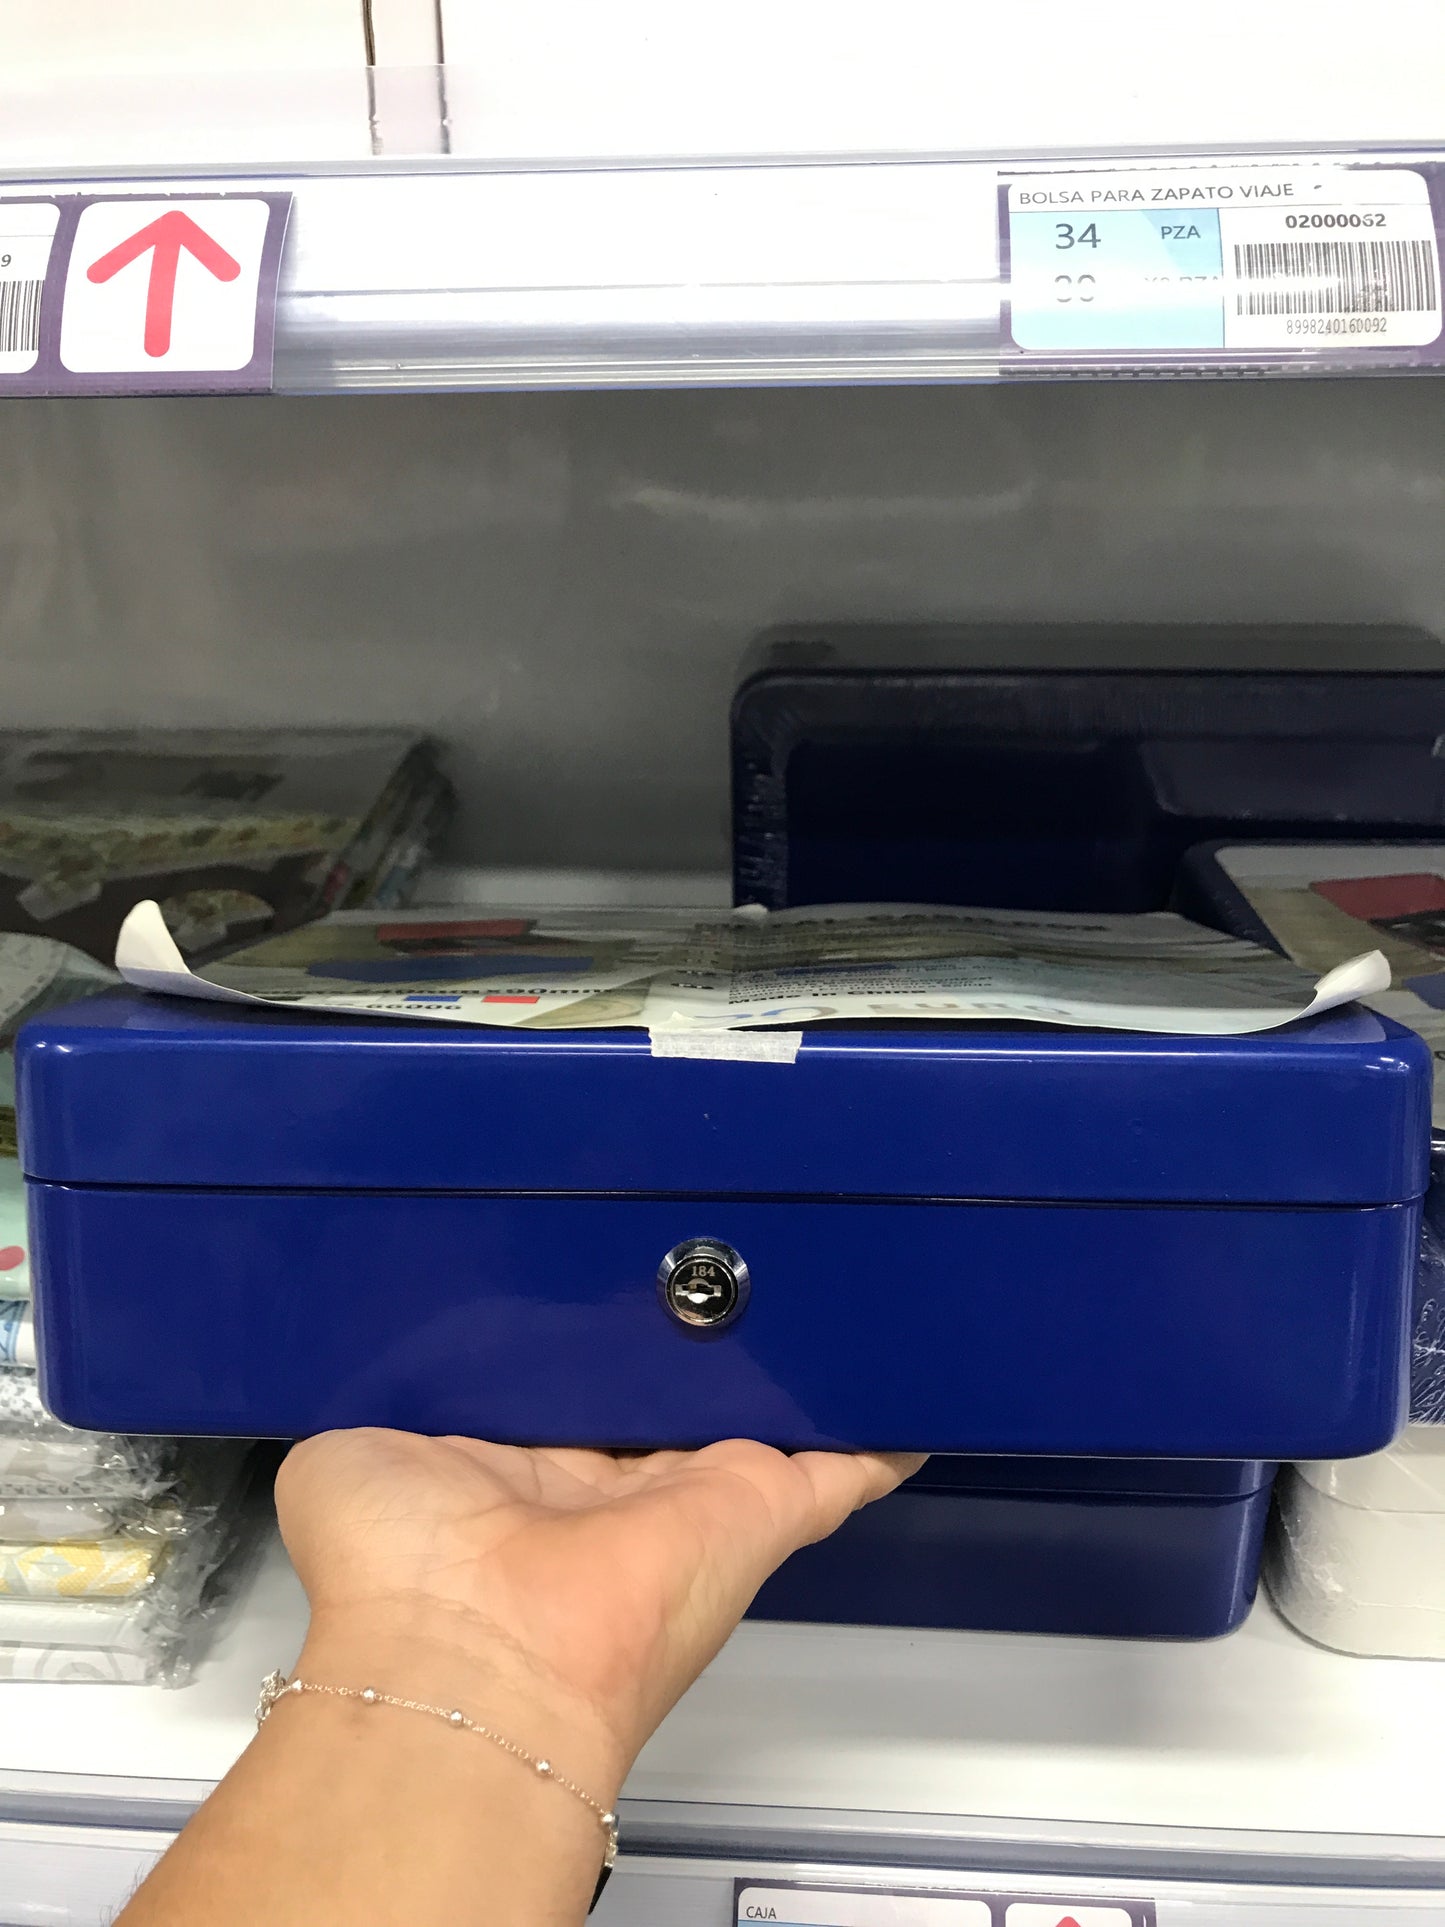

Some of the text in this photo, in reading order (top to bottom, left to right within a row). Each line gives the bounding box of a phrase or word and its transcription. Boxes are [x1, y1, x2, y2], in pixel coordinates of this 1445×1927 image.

[1019, 183, 1295, 205] BOLSA PARA ZAPATO VIAJE
[1285, 213, 1387, 229] 02000062
[1055, 222, 1102, 250] 34
[1161, 225, 1202, 240] PZA
[691, 1265, 716, 1277] 184
[746, 1906, 777, 1919] CAJA
